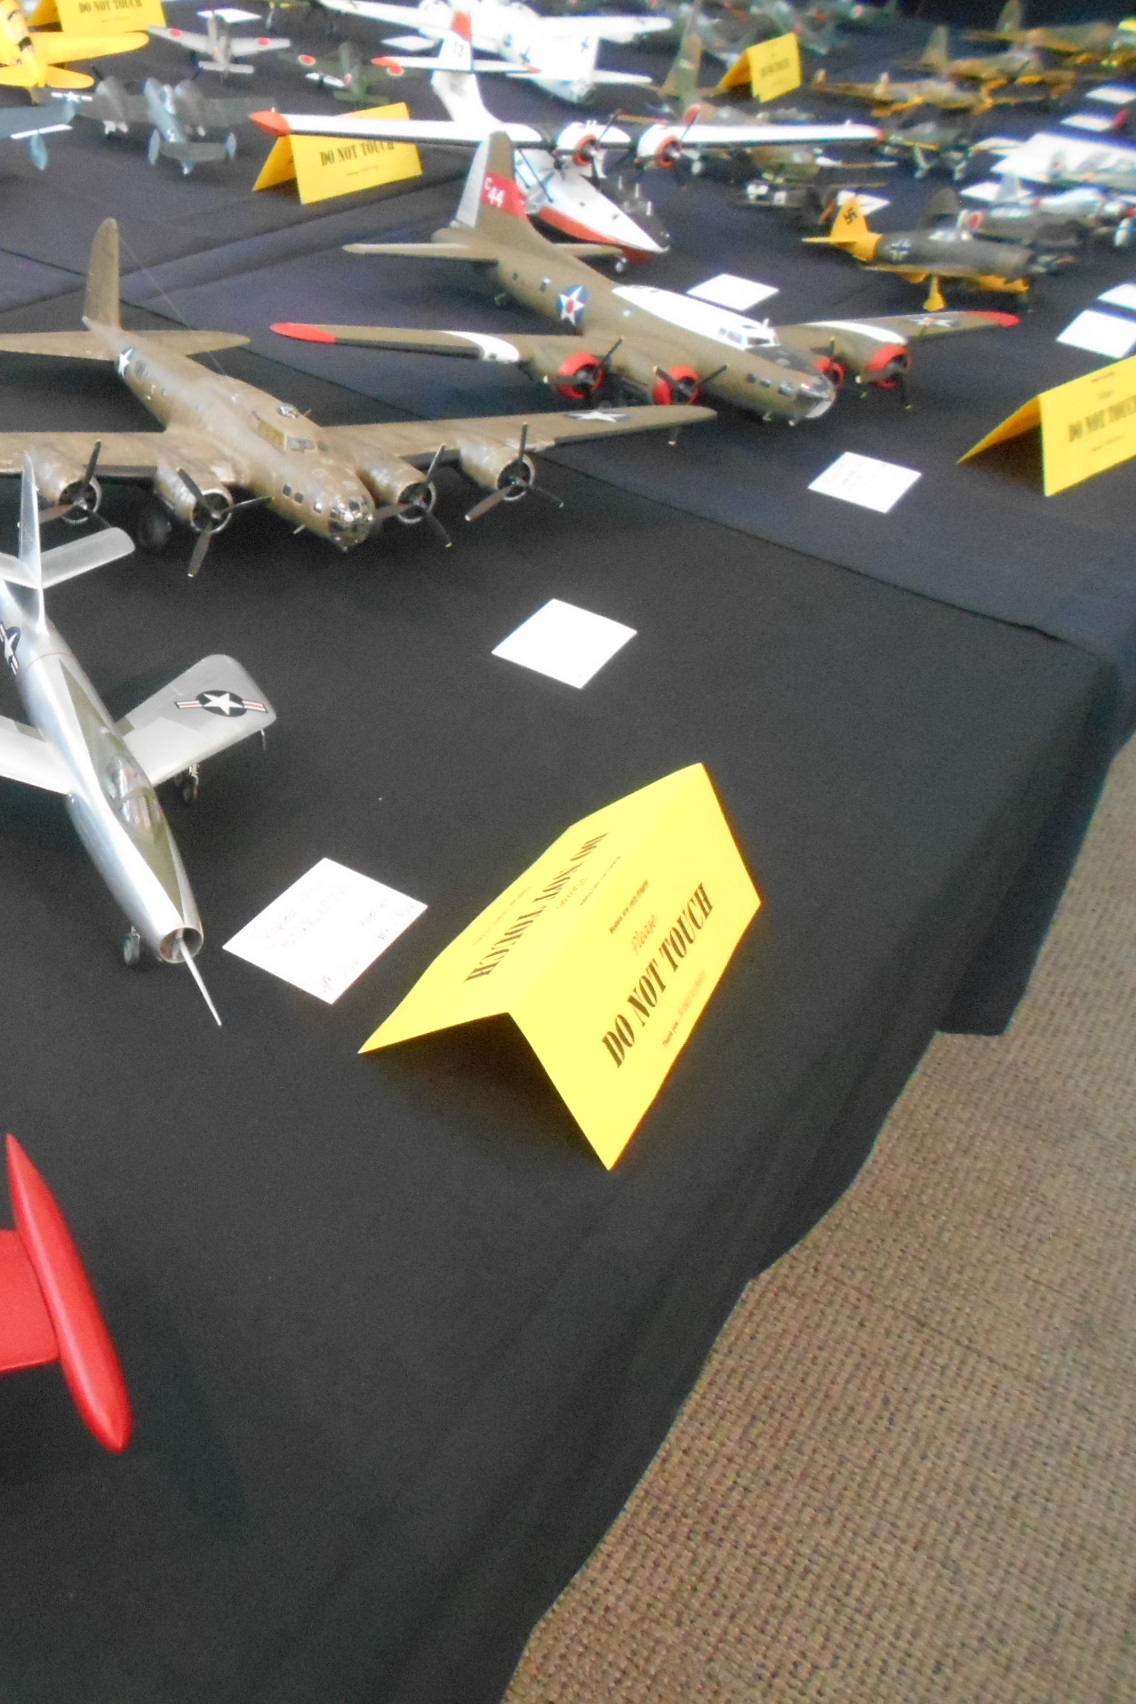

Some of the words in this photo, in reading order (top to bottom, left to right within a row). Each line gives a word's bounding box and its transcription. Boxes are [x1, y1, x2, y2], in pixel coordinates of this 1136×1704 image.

[320, 150, 335, 166] DO
[337, 145, 358, 163] NOT
[487, 186, 505, 208] 44
[531, 861, 584, 903] NOT
[463, 905, 548, 982] TOUCH
[601, 1014, 635, 1069] DO
[627, 958, 667, 1028] NOT
[658, 881, 714, 973] TOUCH
